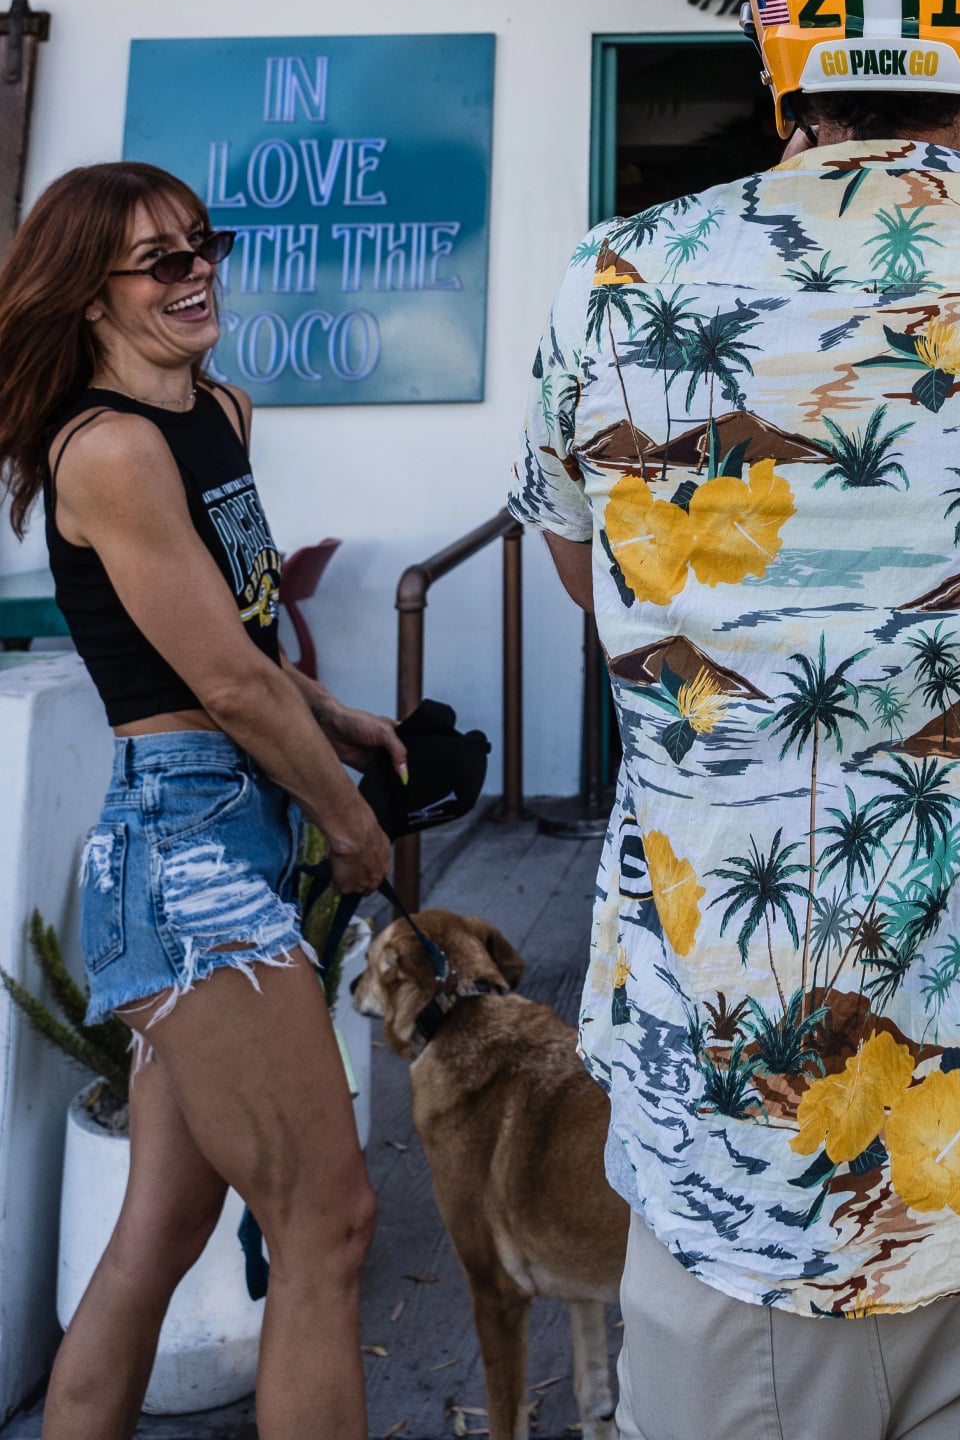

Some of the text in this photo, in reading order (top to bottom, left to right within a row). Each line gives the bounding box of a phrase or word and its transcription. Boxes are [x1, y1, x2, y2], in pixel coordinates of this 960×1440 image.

[263, 56, 328, 122] IN
[820, 49, 939, 77] GO PACK GO
[206, 138, 388, 208] LOVE
[212, 221, 464, 294] TH THE
